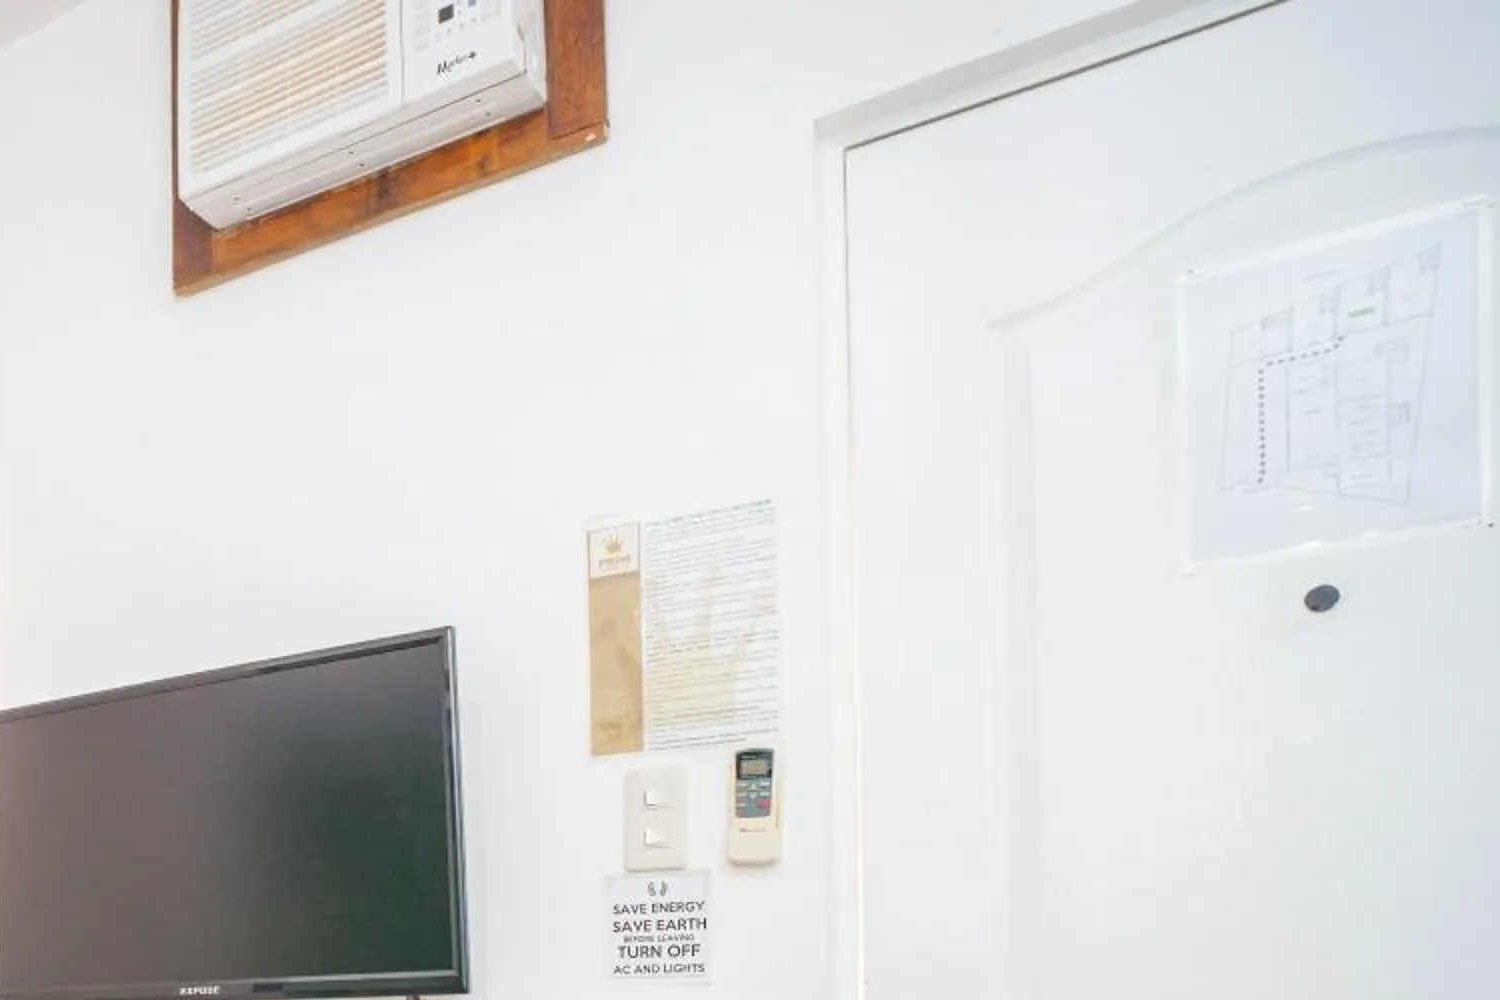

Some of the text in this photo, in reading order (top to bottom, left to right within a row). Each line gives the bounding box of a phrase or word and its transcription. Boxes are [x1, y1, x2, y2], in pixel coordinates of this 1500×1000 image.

[613, 901, 705, 915] SAVE ENERGY
[613, 917, 707, 933] SAVE EARTH
[618, 943, 701, 959] TURN OFF
[613, 963, 705, 974] AC AND LIGHTS
